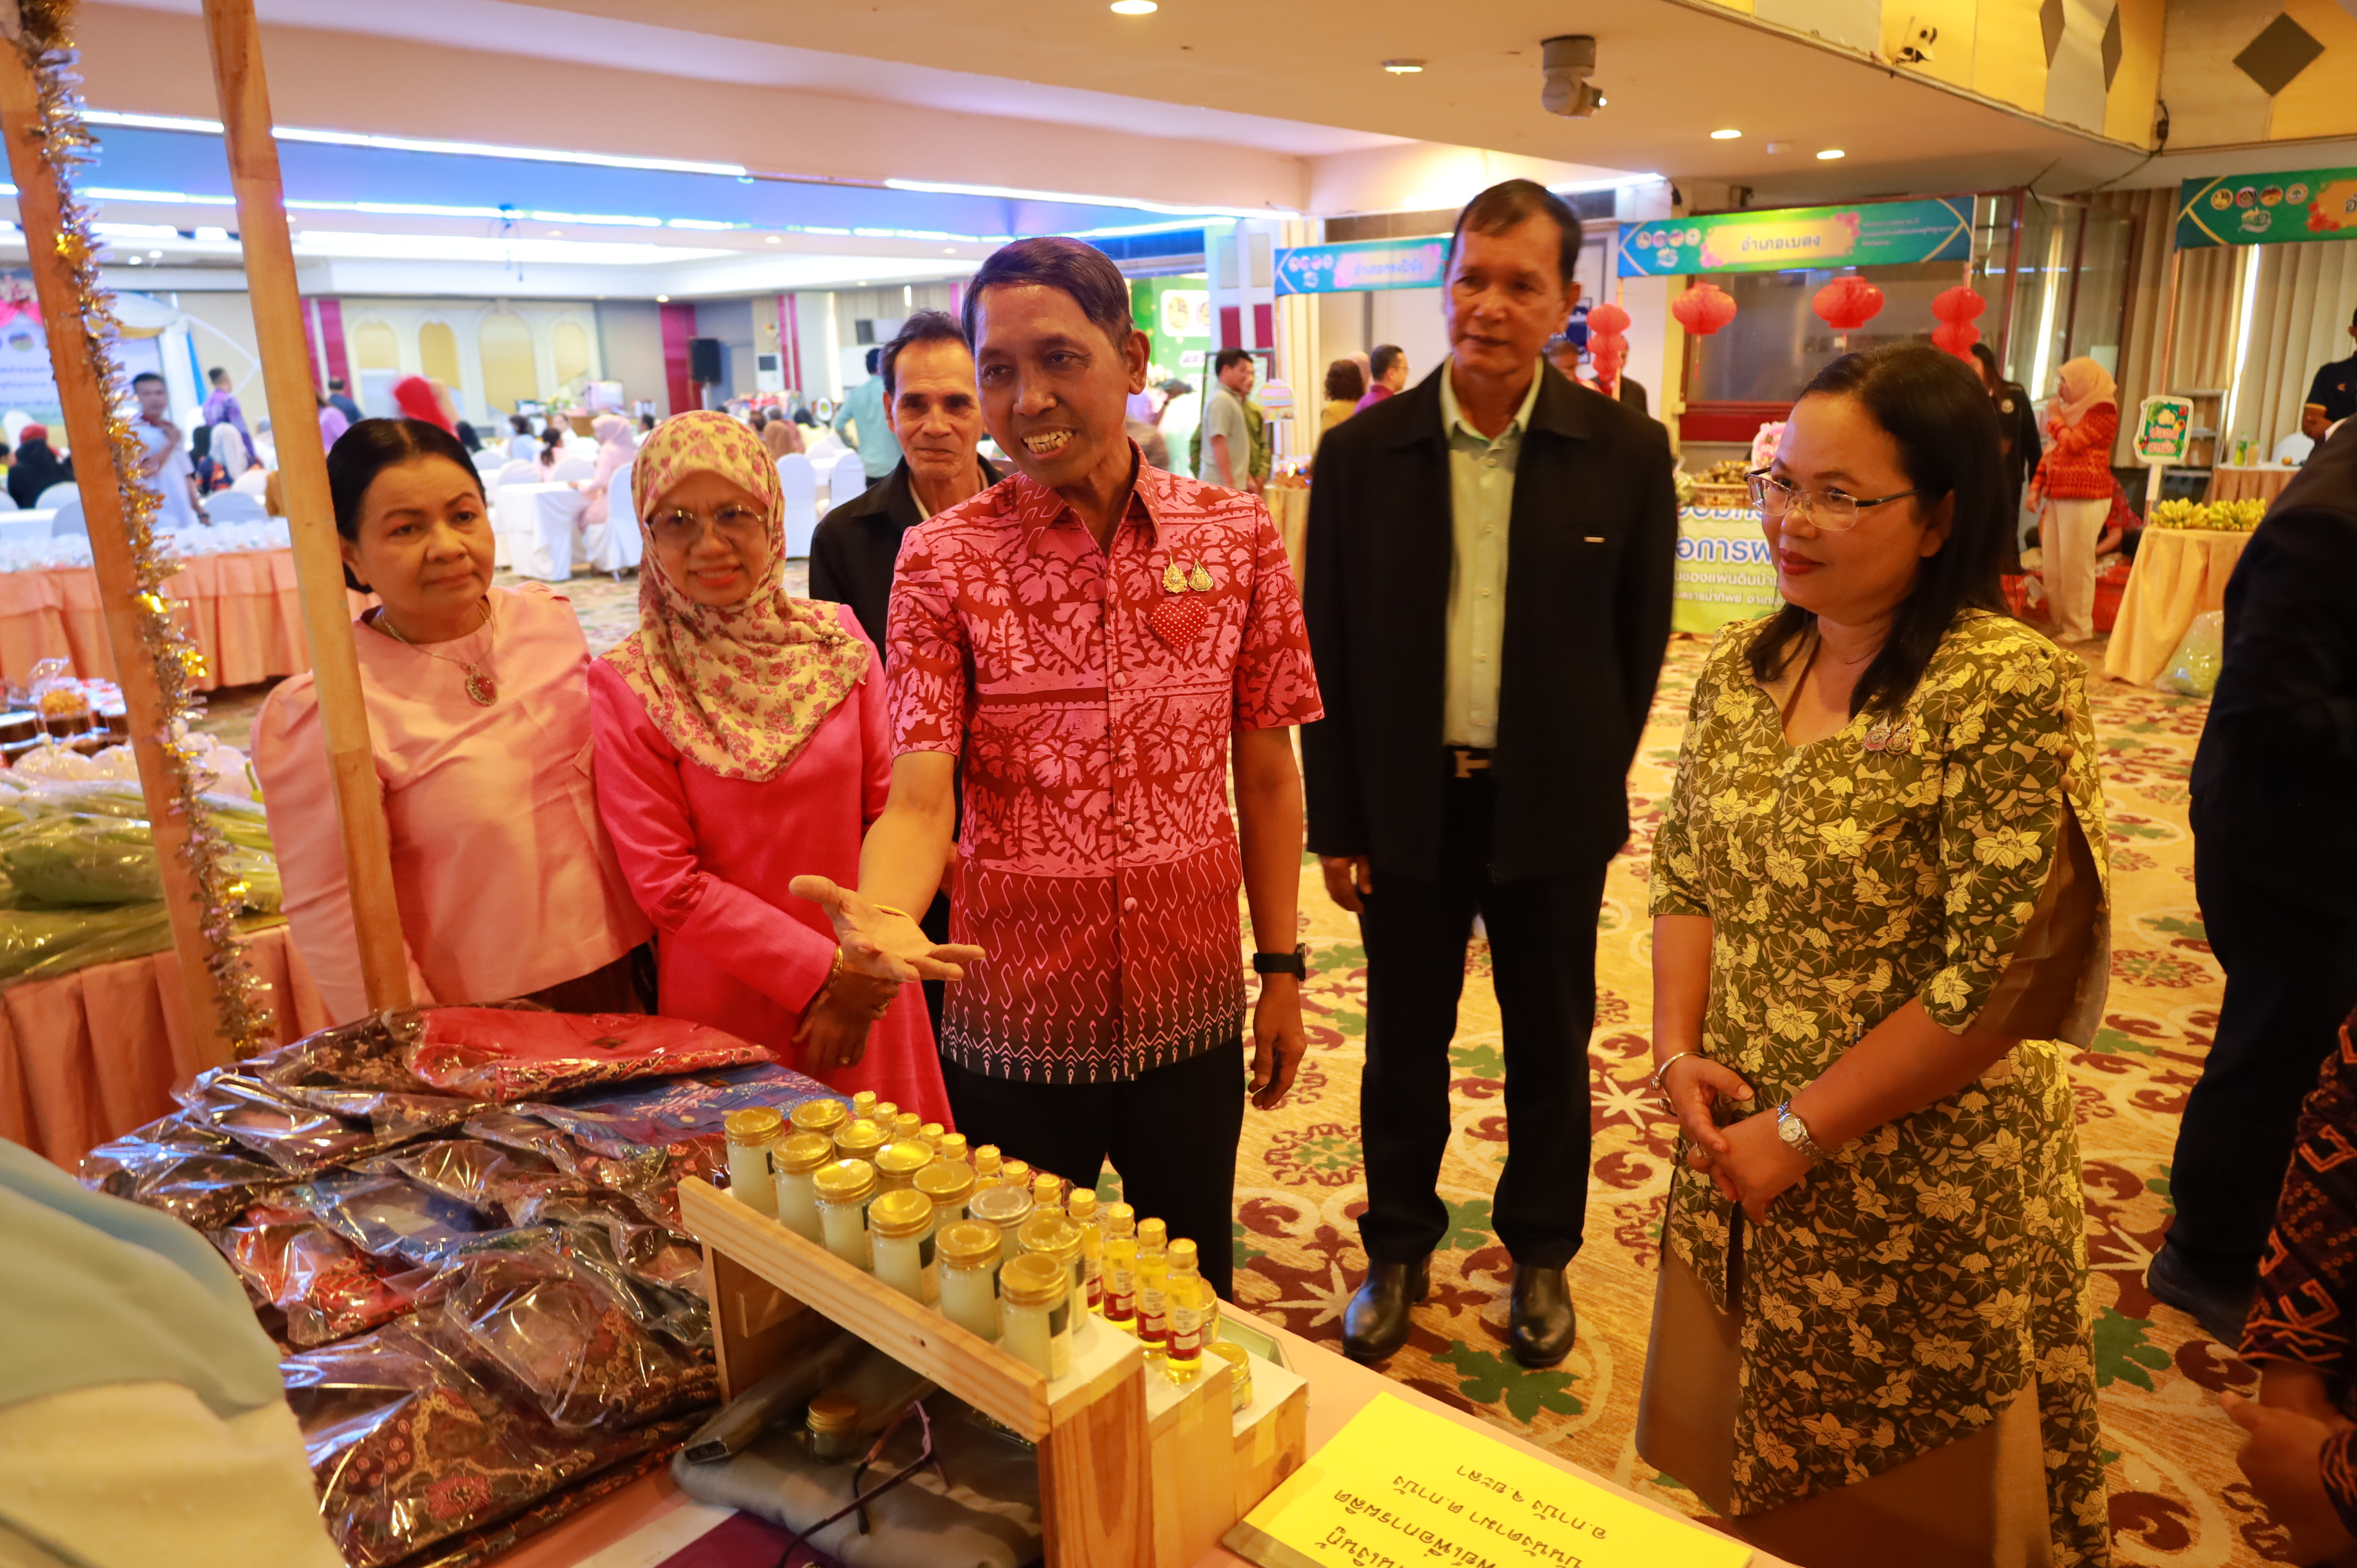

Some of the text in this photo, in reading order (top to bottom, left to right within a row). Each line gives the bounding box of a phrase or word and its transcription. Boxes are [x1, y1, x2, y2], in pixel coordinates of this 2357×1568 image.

[1742, 235, 1821, 252] อำเภอเบตง
[1393, 1476, 1464, 1514] ต.กาบัง
[1456, 1465, 1607, 1539] อ.กาบัง จ.ยะลา
